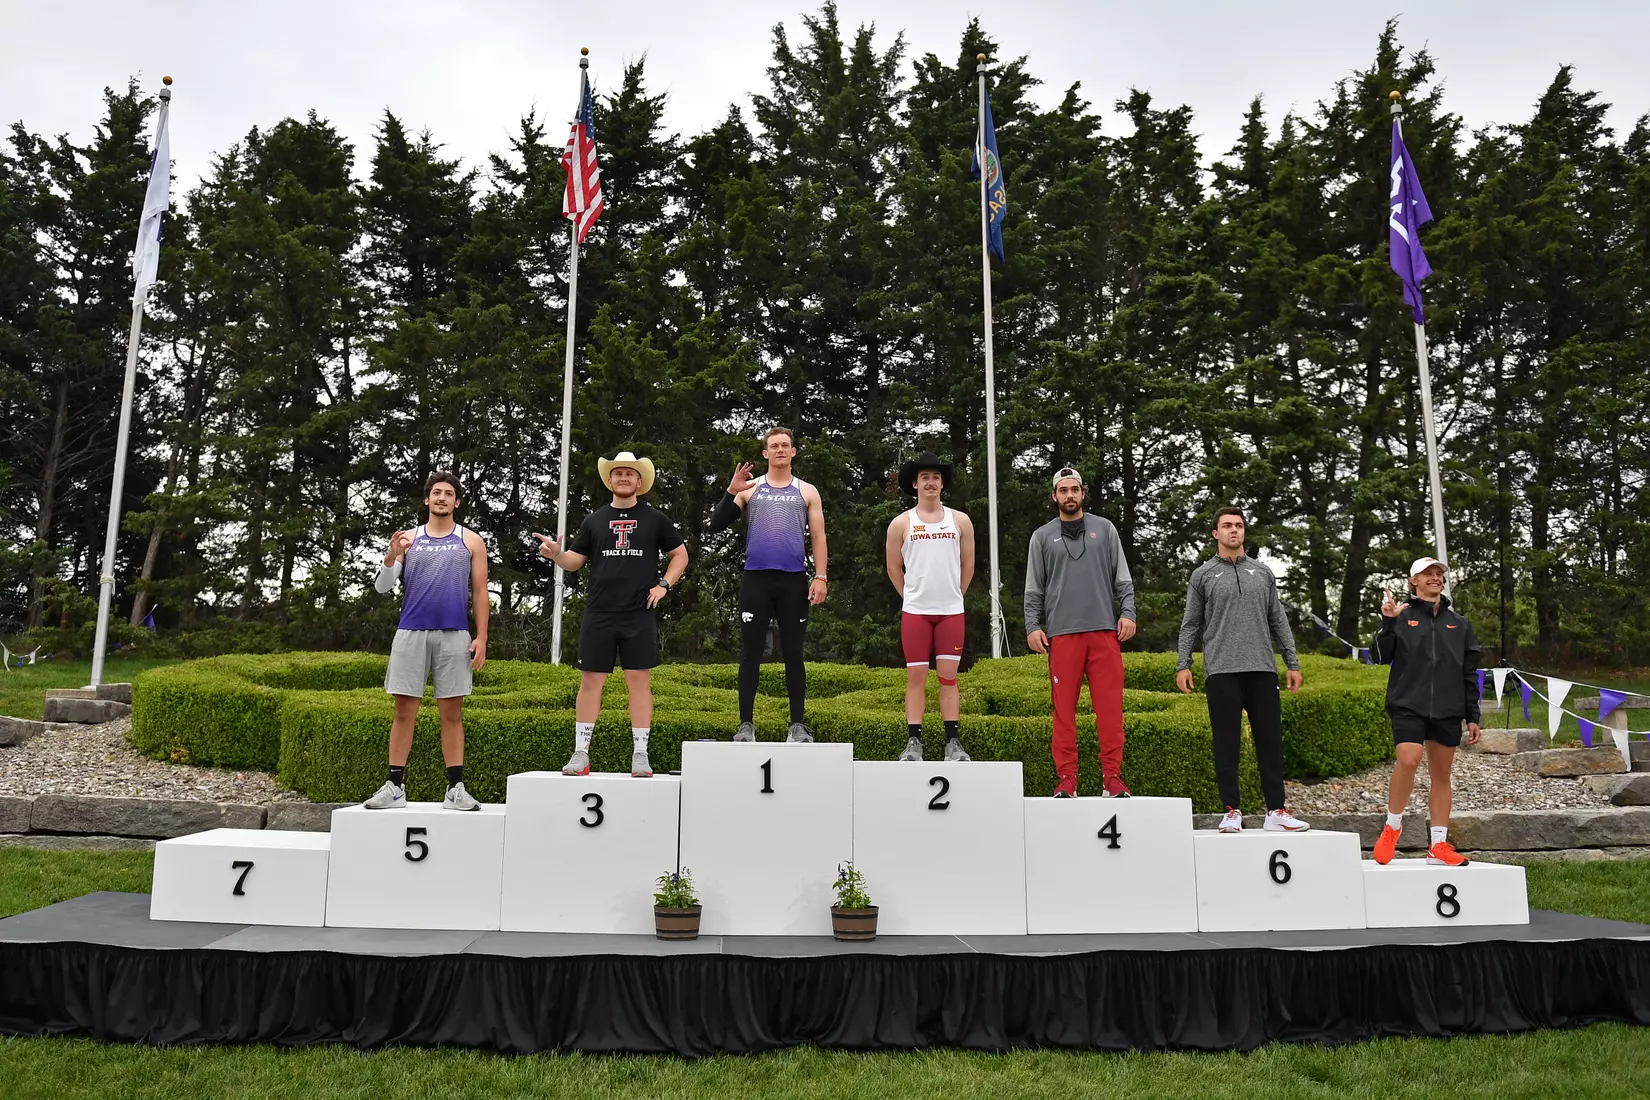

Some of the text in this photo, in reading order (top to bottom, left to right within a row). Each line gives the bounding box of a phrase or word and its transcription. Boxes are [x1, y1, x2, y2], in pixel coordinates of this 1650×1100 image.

[910, 532, 956, 541] IOWA STATE
[760, 758, 775, 794] 1
[927, 776, 951, 811] 2
[579, 792, 604, 829] 3
[404, 827, 429, 863] 5
[1097, 813, 1122, 850] 4
[231, 860, 255, 896] 7
[1268, 849, 1292, 885] 6
[1435, 883, 1461, 919] 8
